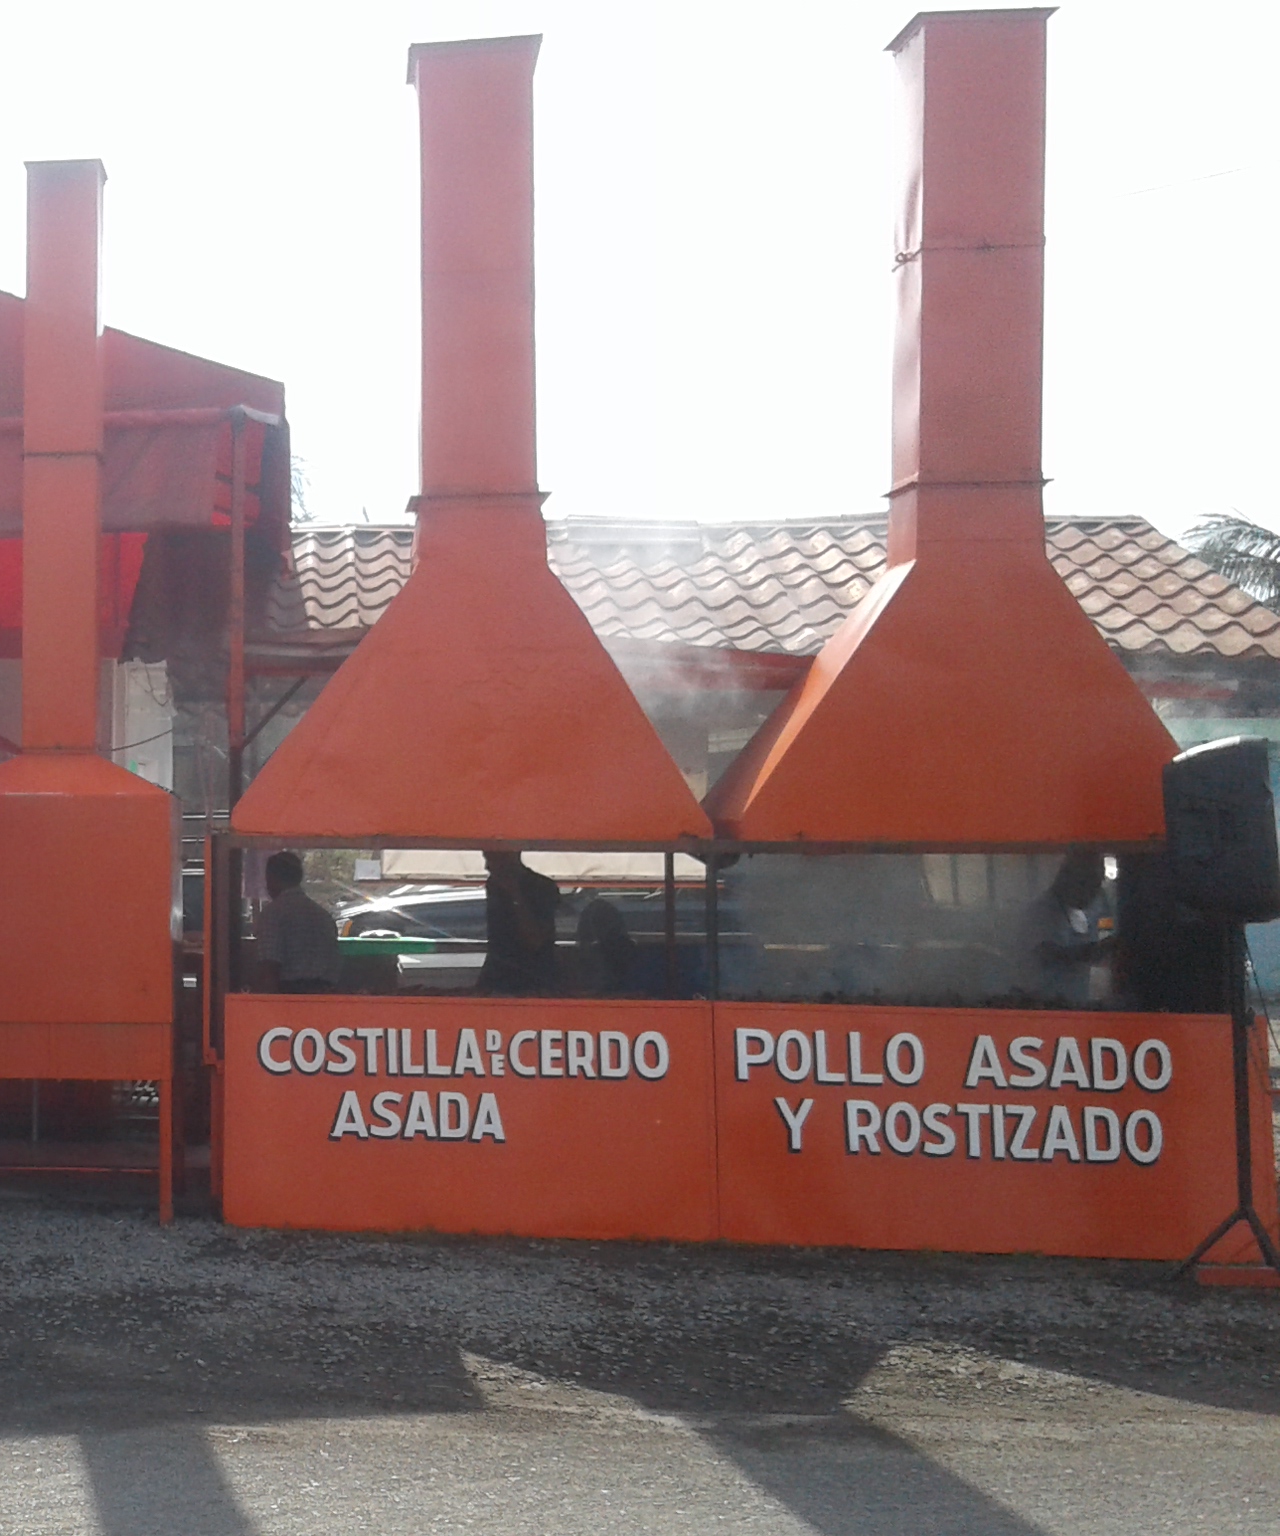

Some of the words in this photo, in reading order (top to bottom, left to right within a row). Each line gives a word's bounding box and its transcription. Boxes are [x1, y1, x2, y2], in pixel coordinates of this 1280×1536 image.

[258, 1026, 485, 1077] COSTILLA
[508, 1029, 670, 1081] CERDO
[734, 1027, 925, 1085] POLLO
[964, 1034, 1173, 1091] ASADO
[329, 1090, 506, 1142] ASADA
[774, 1096, 814, 1152] Y
[844, 1098, 1164, 1166] ROSTIZADO
